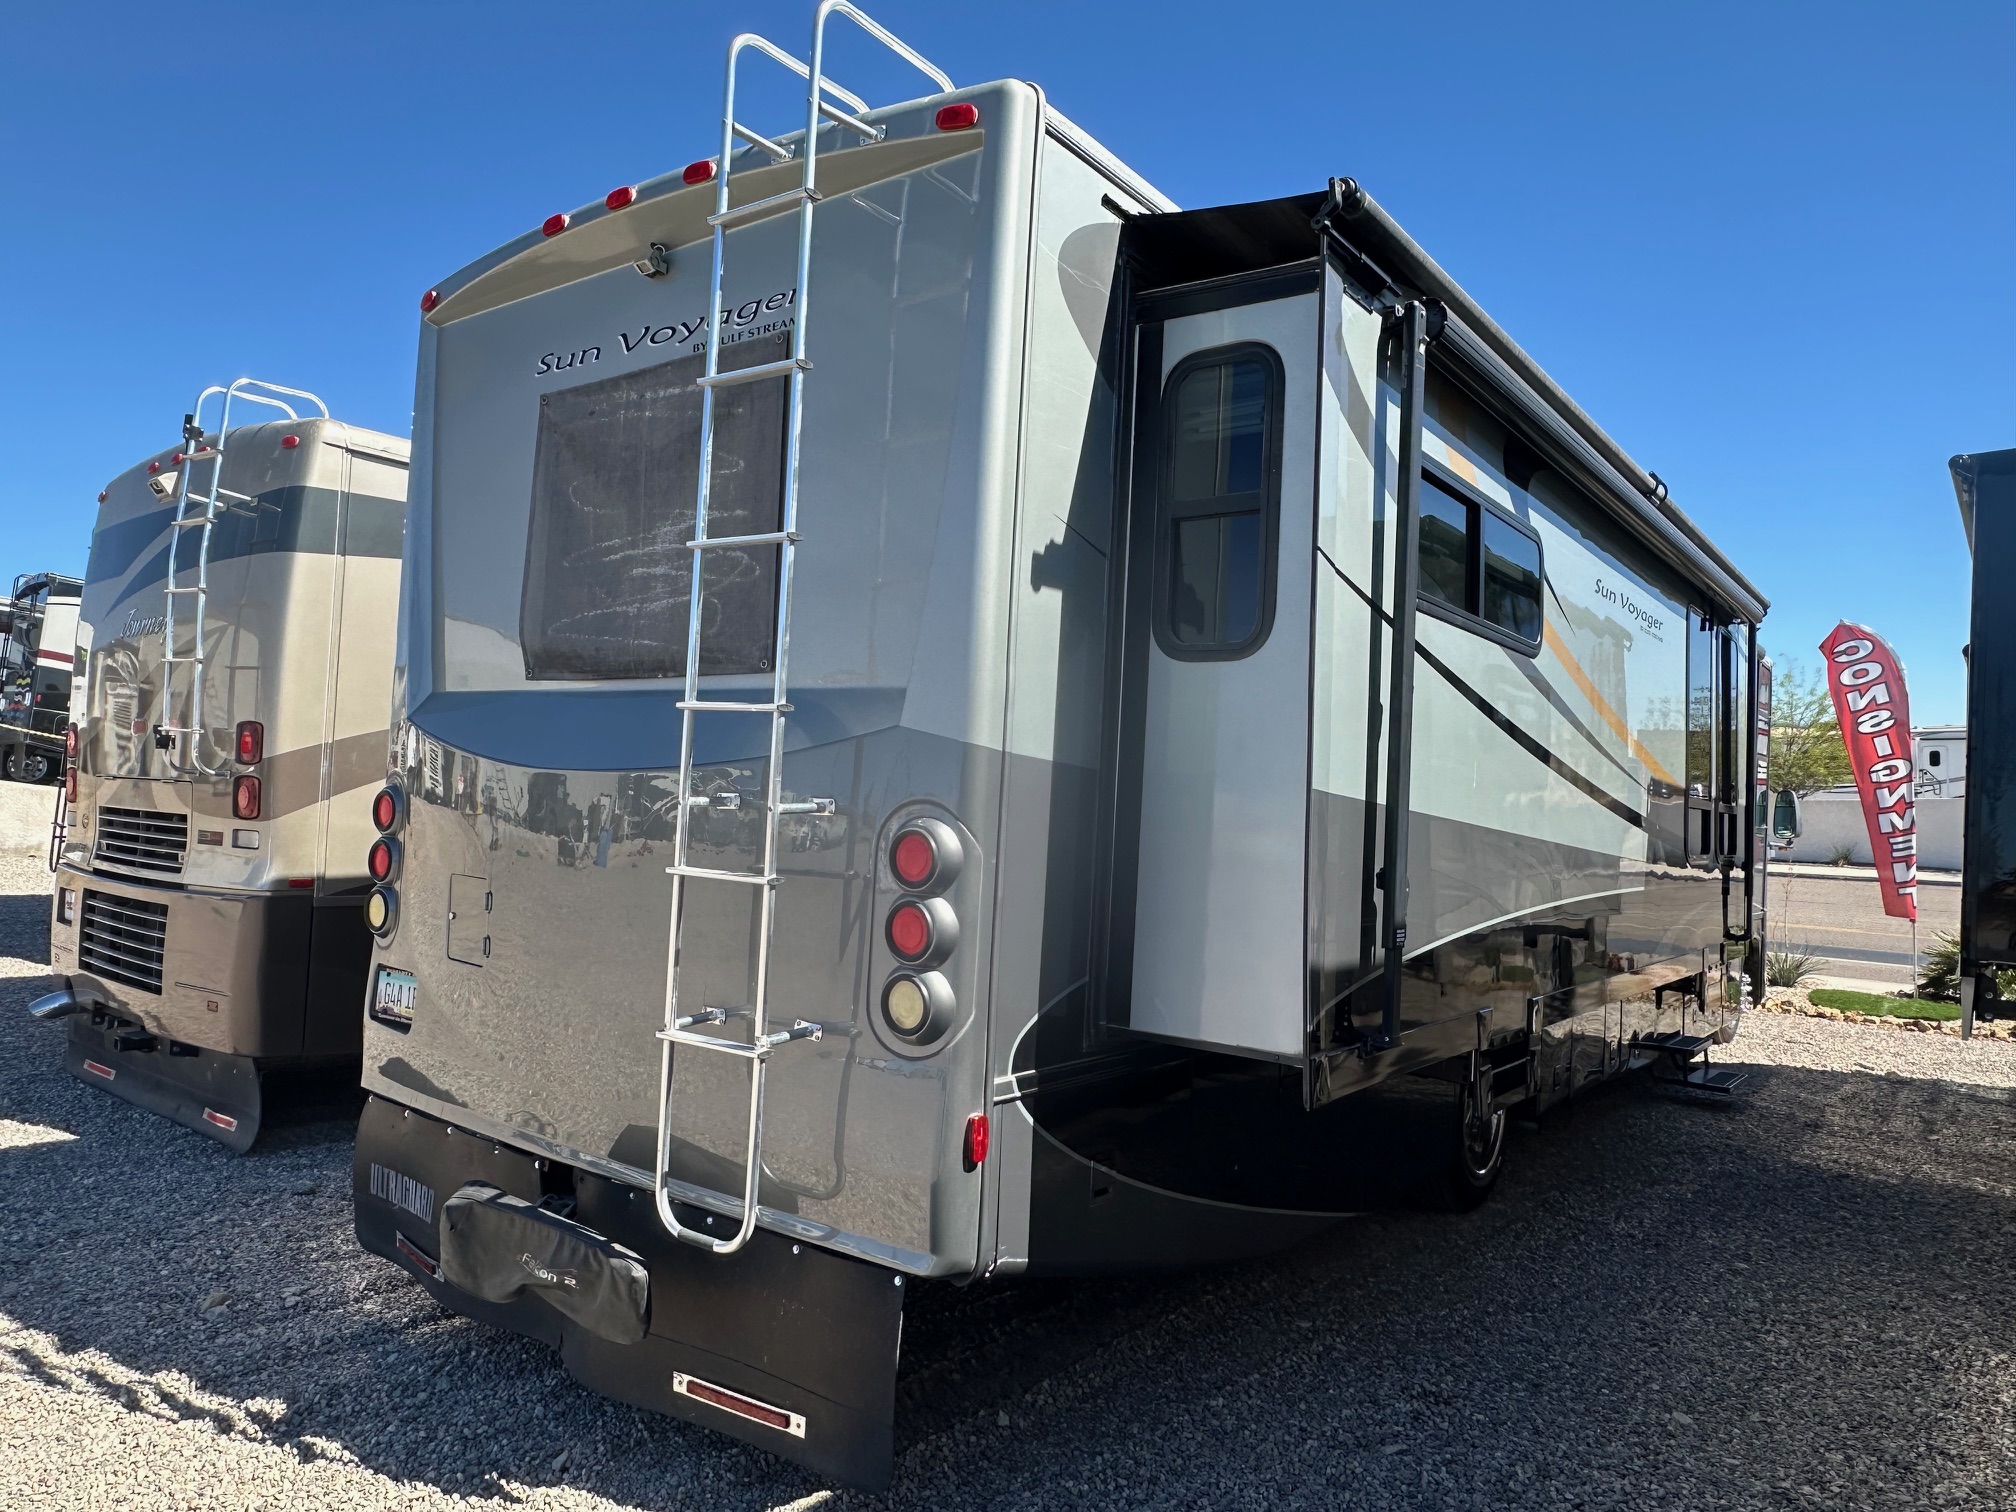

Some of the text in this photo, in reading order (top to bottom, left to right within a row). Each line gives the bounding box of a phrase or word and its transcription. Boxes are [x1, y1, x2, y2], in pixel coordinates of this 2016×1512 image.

[535, 288, 798, 377] Sun Voyager
[693, 340, 708, 354] BY
[719, 330, 745, 346] ULF
[1594, 578, 1664, 631] Sun Voyager
[370, 1162, 435, 1225] ULTRAGUARD
